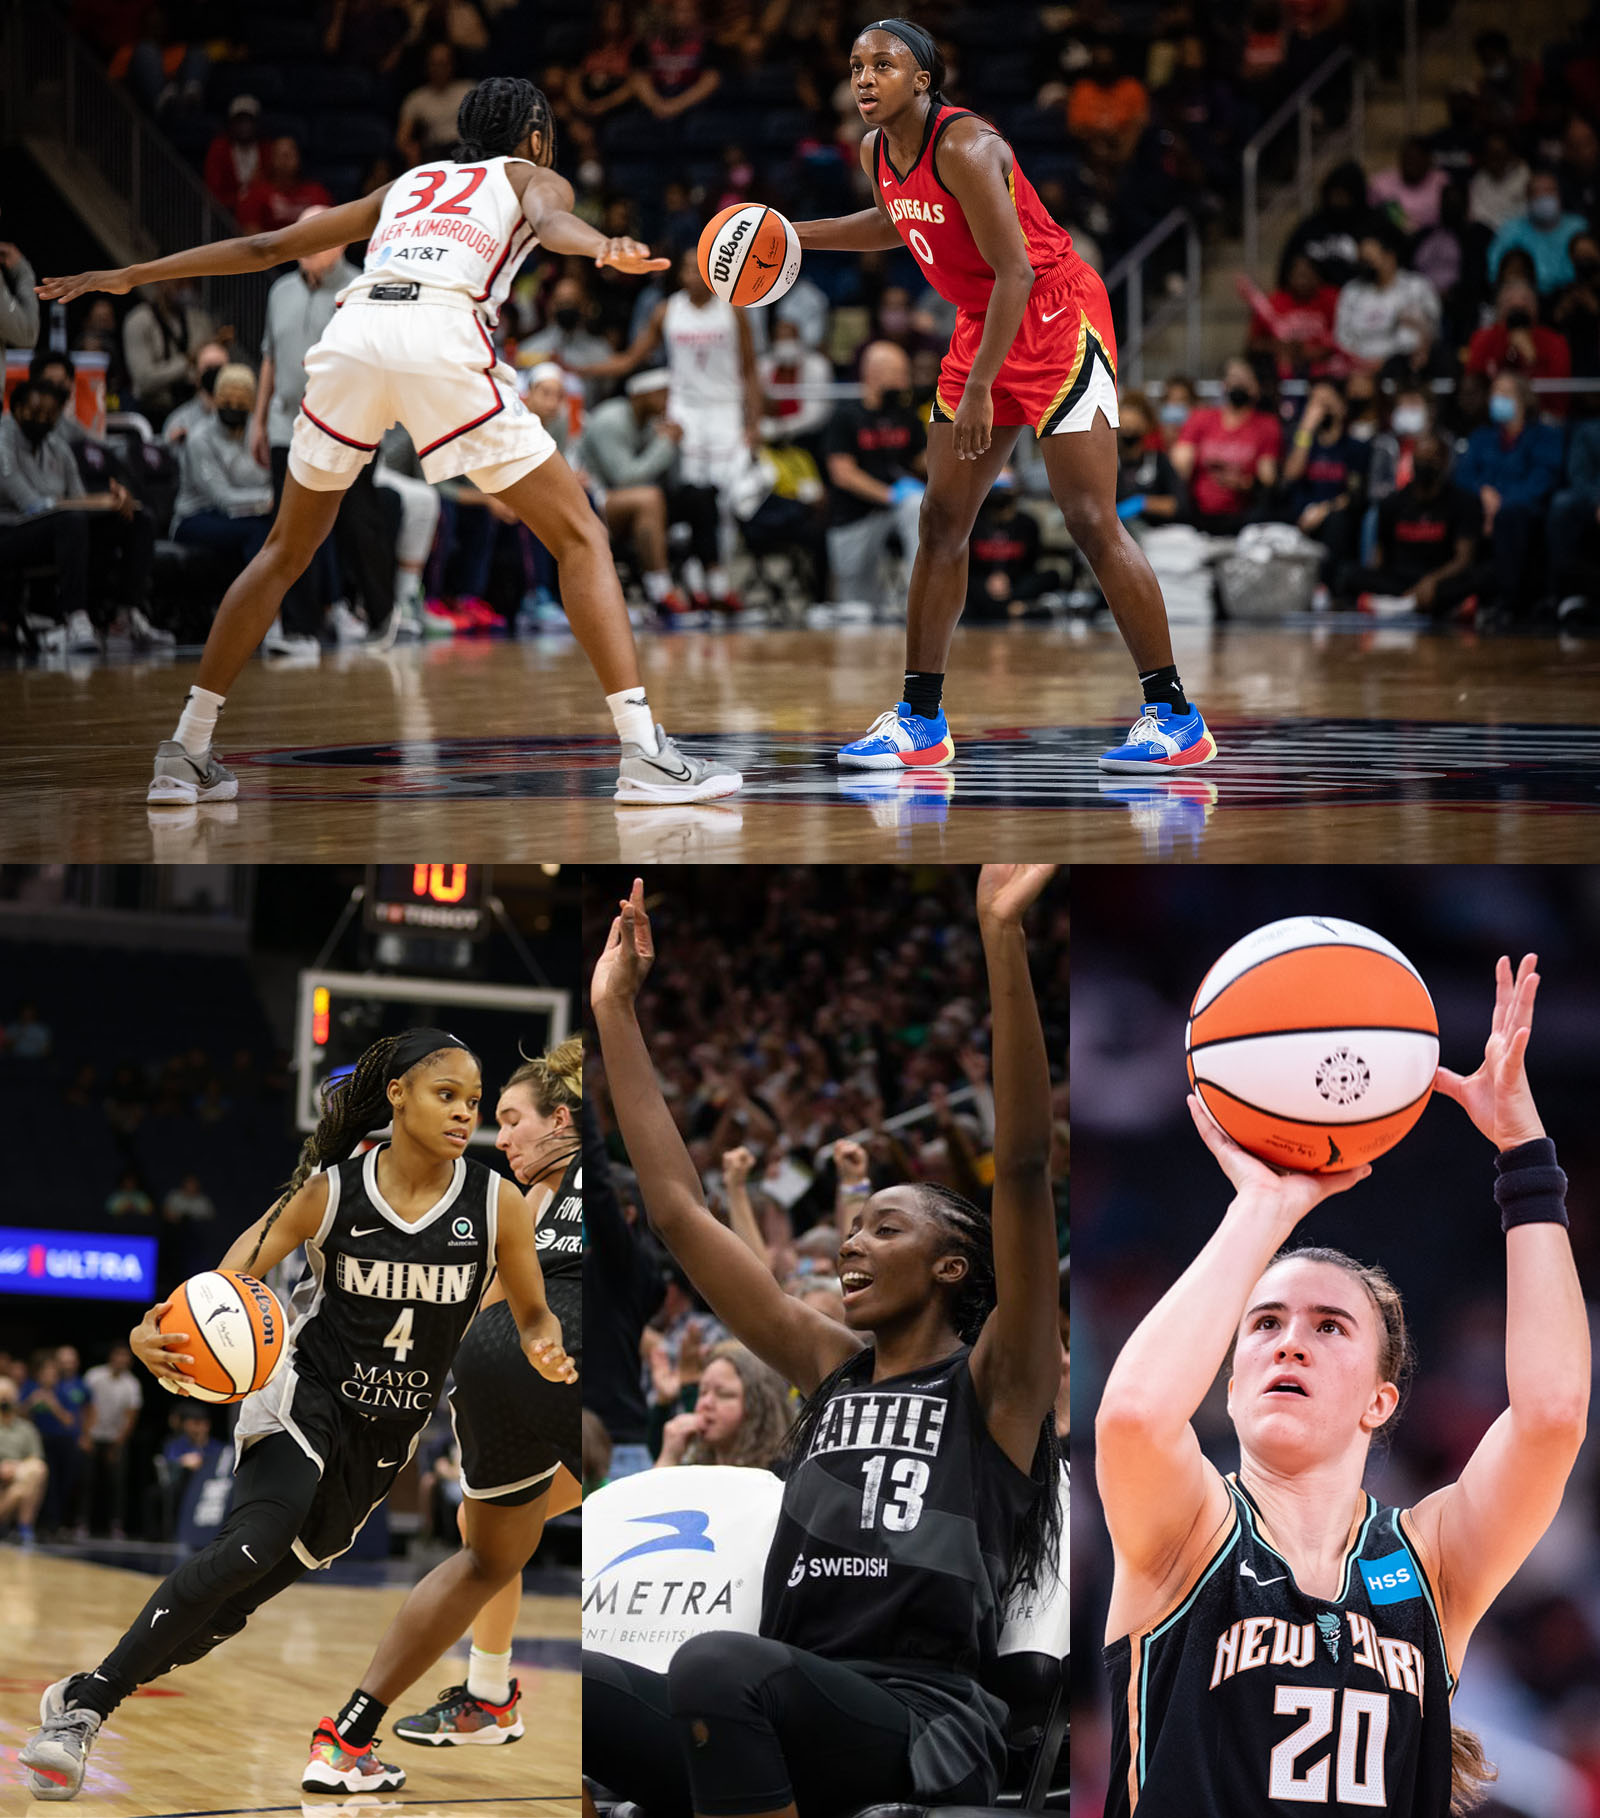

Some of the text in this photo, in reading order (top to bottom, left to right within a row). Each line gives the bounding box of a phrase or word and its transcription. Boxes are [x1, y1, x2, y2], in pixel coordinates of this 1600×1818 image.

[395, 167, 487, 218] 32
[394, 247, 448, 261] AT&T
[714, 220, 752, 283] Wilson
[909, 228, 934, 265] 0
[413, 865, 467, 902] 10
[46, 1249, 143, 1282] ULTRA
[341, 1255, 473, 1303] MINN
[235, 1273, 274, 1346] Wilson
[383, 1308, 414, 1362] 4
[352, 1362, 429, 1388] MAYO
[341, 1380, 432, 1410] CLINIC
[860, 1455, 930, 1532] 13
[809, 1558, 888, 1577] SWEDISH
[1368, 1568, 1411, 1591] HSS
[582, 1579, 732, 1615] METRA
[620, 1630, 686, 1643] BENEFITS
[1209, 1616, 1315, 1690] NEW
[1269, 1685, 1389, 1807] 20
